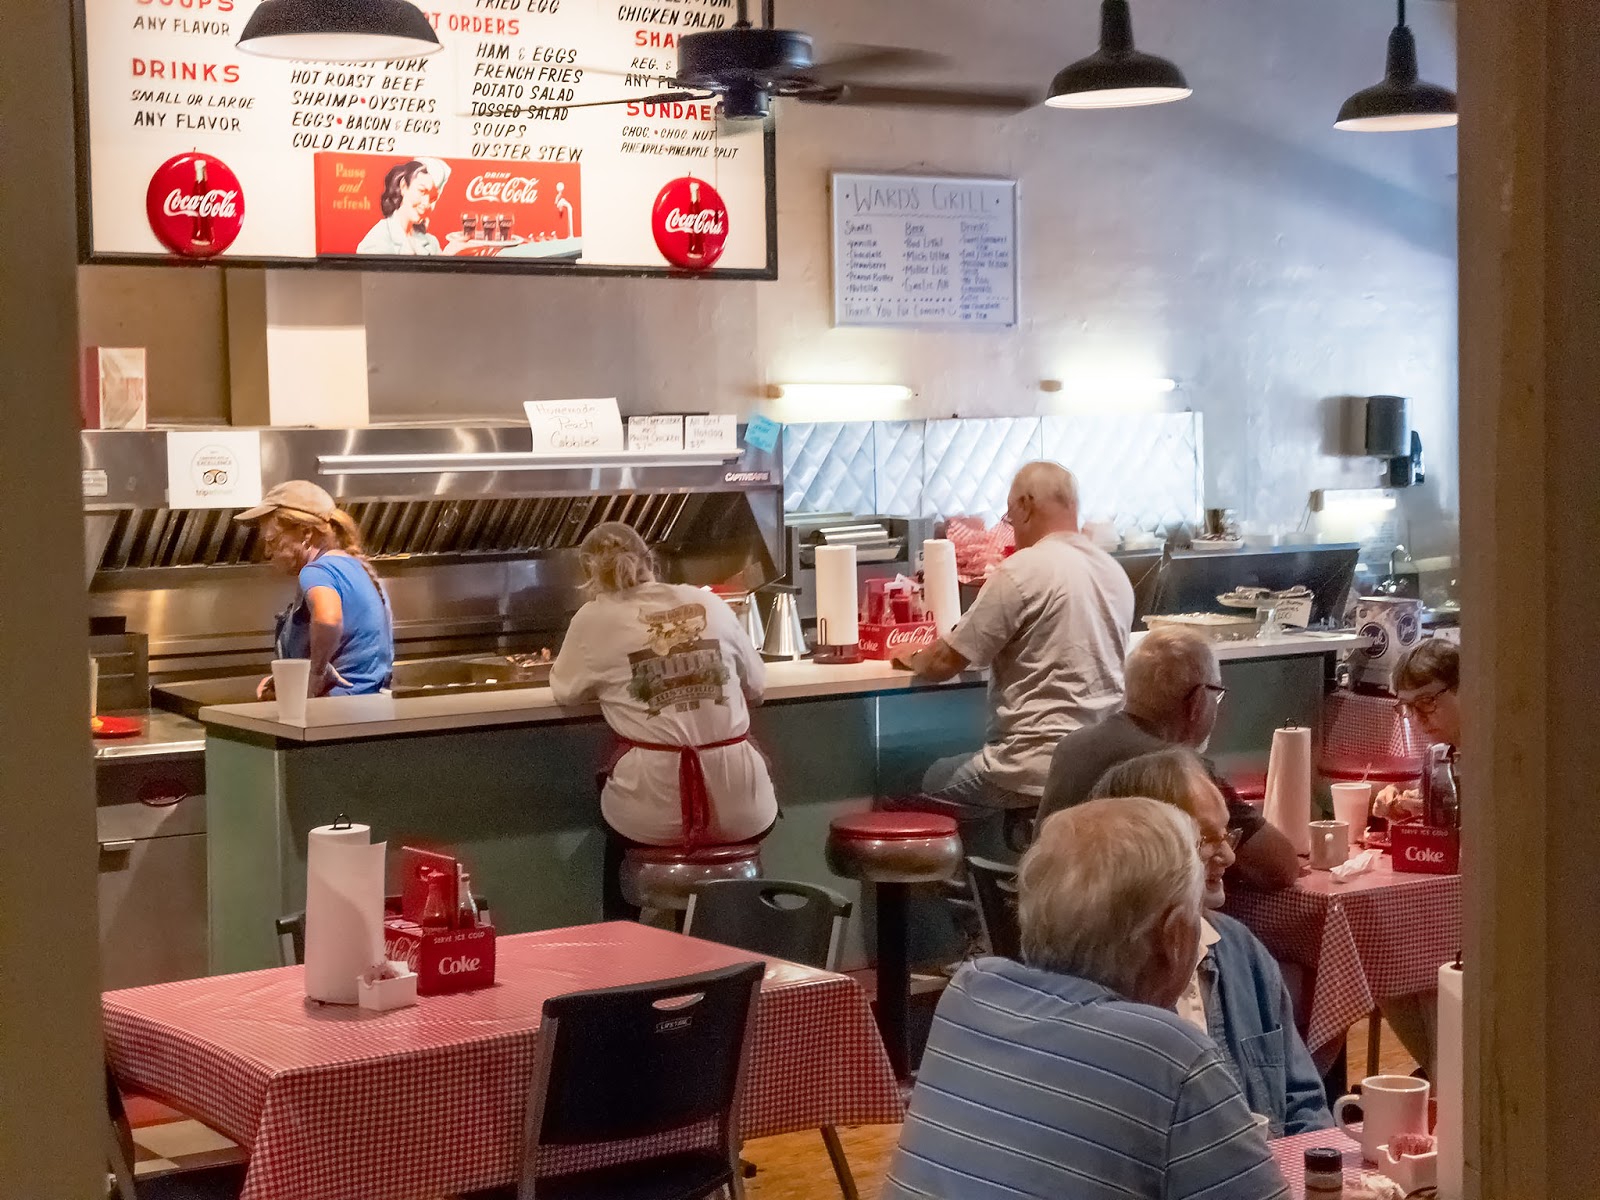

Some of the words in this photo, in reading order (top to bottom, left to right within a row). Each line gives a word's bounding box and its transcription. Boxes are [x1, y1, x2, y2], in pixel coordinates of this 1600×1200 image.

[527, 0, 560, 14] EGG
[133, 16, 167, 31] ANY
[174, 18, 230, 36] FLAVOR
[449, 14, 520, 35] ORDERS
[618, 5, 680, 27] CHICKEN
[683, 11, 725, 30] SALAD
[476, 42, 510, 60] HAM
[532, 46, 577, 64] EGGS
[132, 57, 240, 83] DRINKS
[474, 62, 536, 81] FRENCH
[538, 66, 583, 84] FRIES
[631, 56, 659, 71] REG.
[291, 70, 321, 85] HOT
[325, 73, 375, 88] ROAST
[382, 76, 425, 92] BEEF
[625, 73, 651, 88] ANY
[131, 89, 181, 104] SMALL
[187, 93, 204, 106] OR
[291, 90, 359, 108] SHRIMP
[368, 95, 436, 113] OYSTERS
[472, 82, 524, 99] POTATO
[529, 85, 574, 102] SALAD
[471, 101, 521, 119] TOSSED
[527, 105, 569, 121] SALAD
[627, 100, 716, 121] SUNDAE
[133, 111, 167, 127] ANY
[176, 113, 241, 132] FLAVOR
[292, 111, 335, 128] EGGS
[346, 116, 391, 132] BACON
[404, 118, 441, 135] EGGS
[472, 121, 527, 139] SOUPS
[293, 132, 334, 149] COLD
[337, 135, 396, 152] PLATES
[692, 130, 717, 141] NUT
[471, 142, 532, 160] OYSTER
[537, 145, 583, 163] STEW
[714, 147, 739, 159] SPLIT
[335, 162, 366, 178] Pause
[484, 171, 512, 179] DRINK
[338, 179, 364, 193] and
[465, 175, 540, 205] Coca-Cola
[163, 187, 237, 218] Coca-Cola
[333, 195, 371, 210] refresh
[932, 184, 992, 213] GRILL
[665, 207, 725, 234] Coca-Cola
[858, 638, 879, 652] Coke
[886, 625, 936, 648] Coca-Cola
[1405, 846, 1444, 862] Coke
[433, 936, 452, 945] SERVE
[468, 932, 485, 941] COLD
[438, 955, 481, 975] Coke
